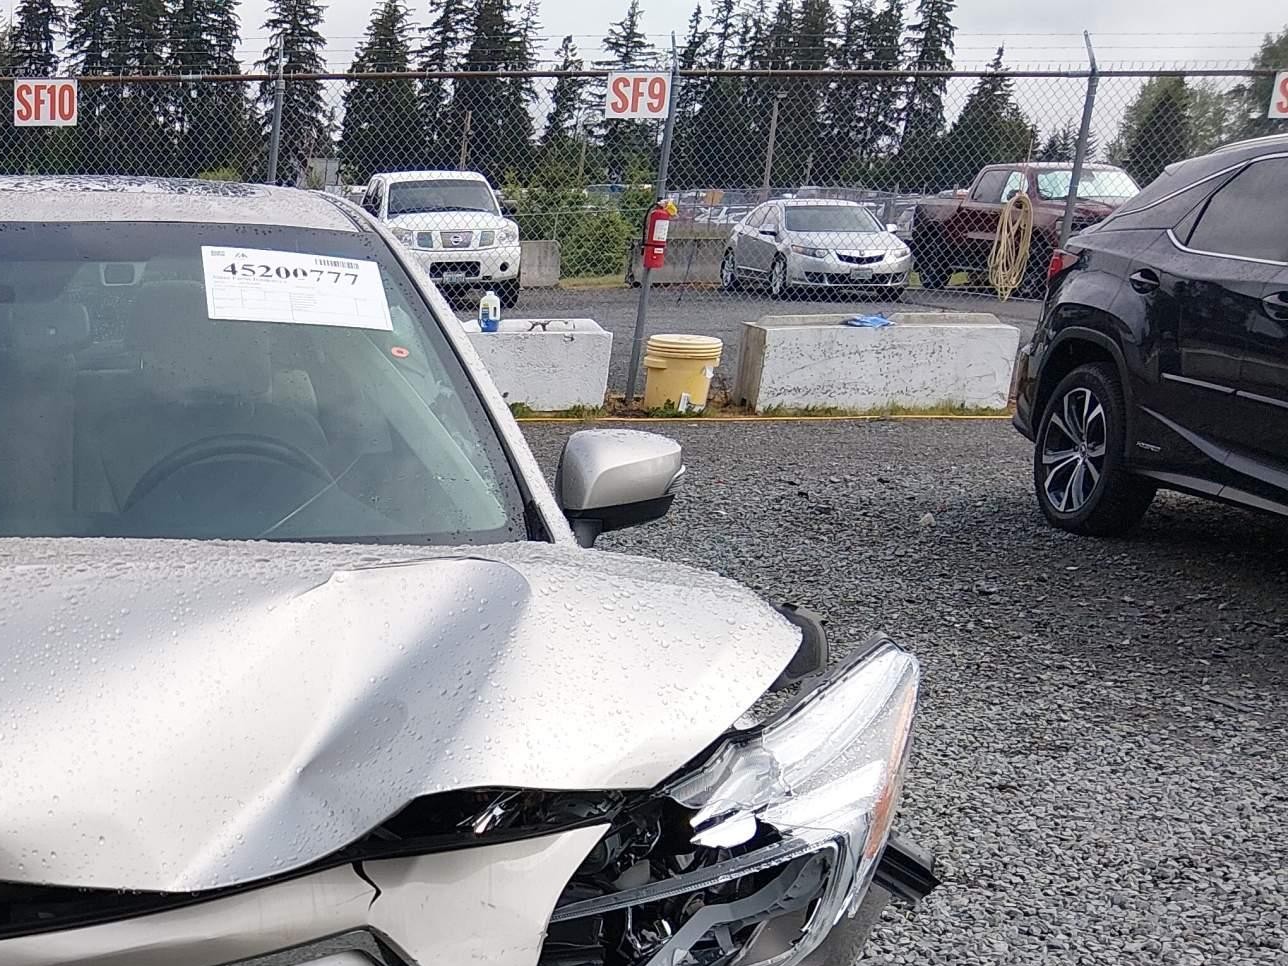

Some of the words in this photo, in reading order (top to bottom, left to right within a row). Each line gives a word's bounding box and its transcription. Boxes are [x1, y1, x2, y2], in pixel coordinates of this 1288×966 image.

[16, 84, 75, 121] SF10
[611, 76, 666, 113] SF9
[222, 262, 359, 285] 45200777
